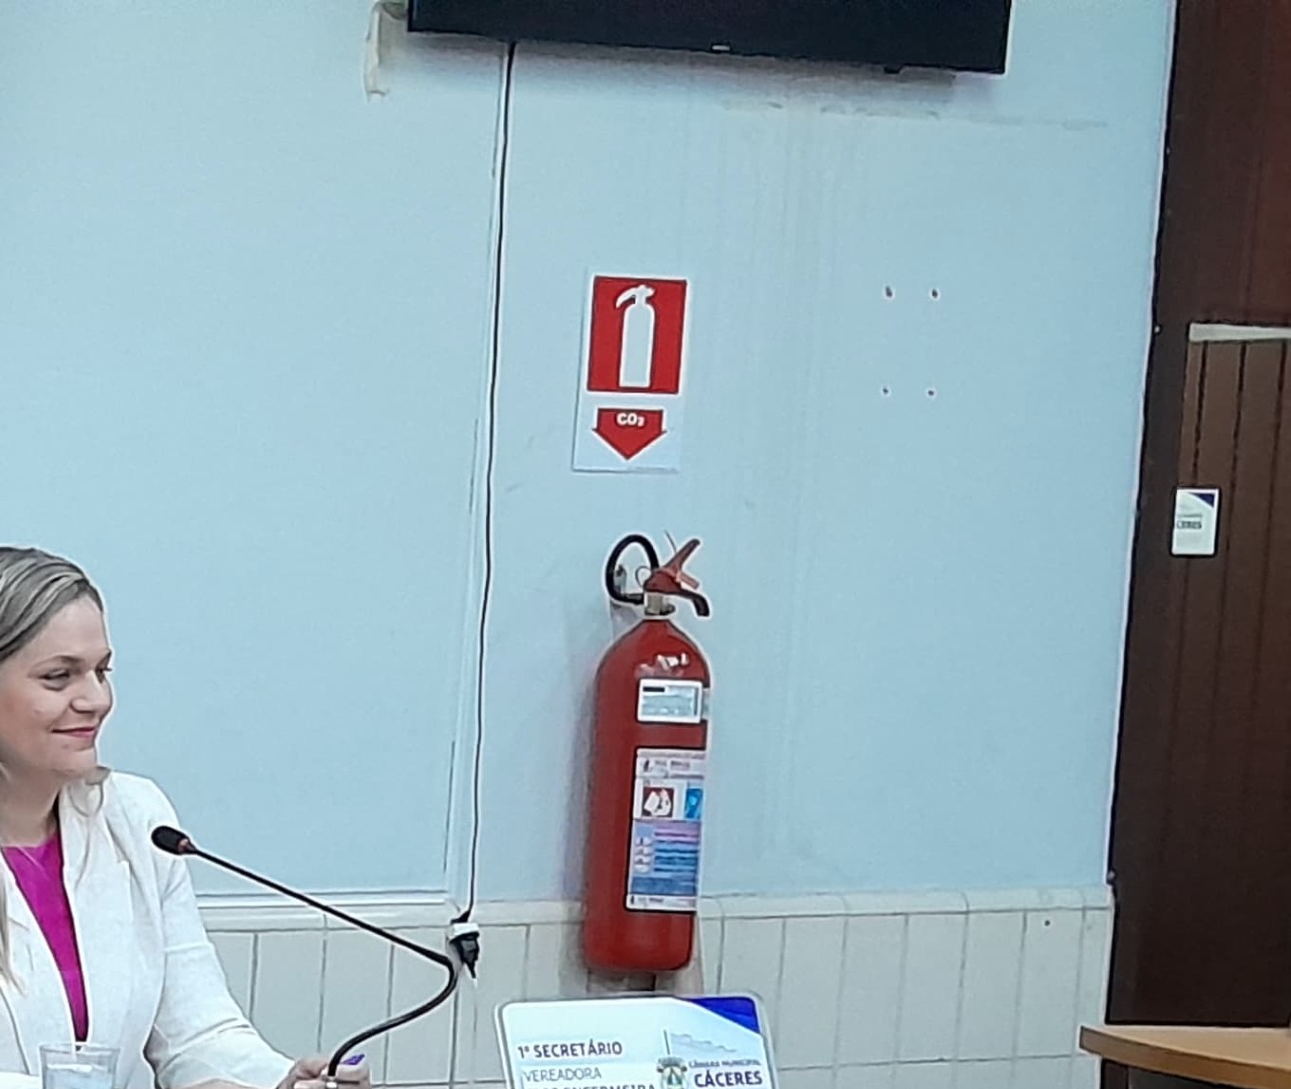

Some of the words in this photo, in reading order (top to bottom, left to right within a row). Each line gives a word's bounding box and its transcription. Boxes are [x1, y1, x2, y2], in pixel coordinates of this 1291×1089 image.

[534, 1038, 623, 1058] SECRETÁRIO
[522, 1067, 602, 1082] VEREADORA
[694, 1070, 763, 1088] CÁCERES
